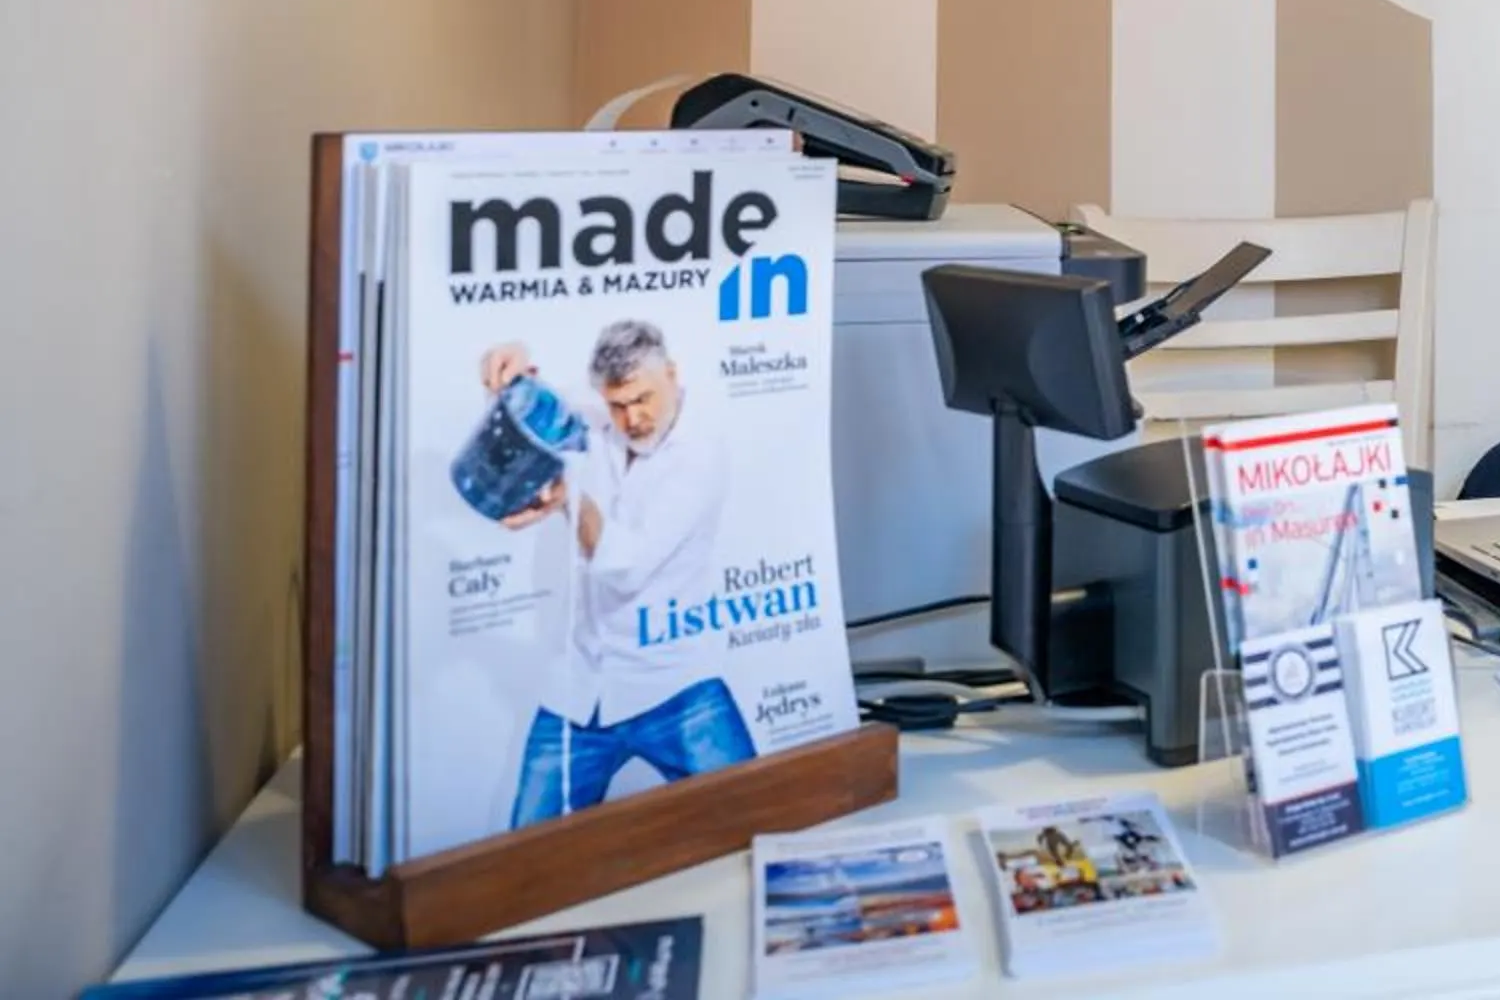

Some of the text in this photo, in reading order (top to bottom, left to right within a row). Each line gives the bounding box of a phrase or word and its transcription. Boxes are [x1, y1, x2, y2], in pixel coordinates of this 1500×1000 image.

[449, 170, 779, 274] made
[450, 268, 711, 304] WARMIA & MAZURY
[718, 252, 808, 321] in
[719, 352, 808, 377] Maleszka
[1238, 443, 1391, 494] MIKOŁAJKI
[724, 555, 814, 593] Robert
[638, 580, 817, 647] Listwan
